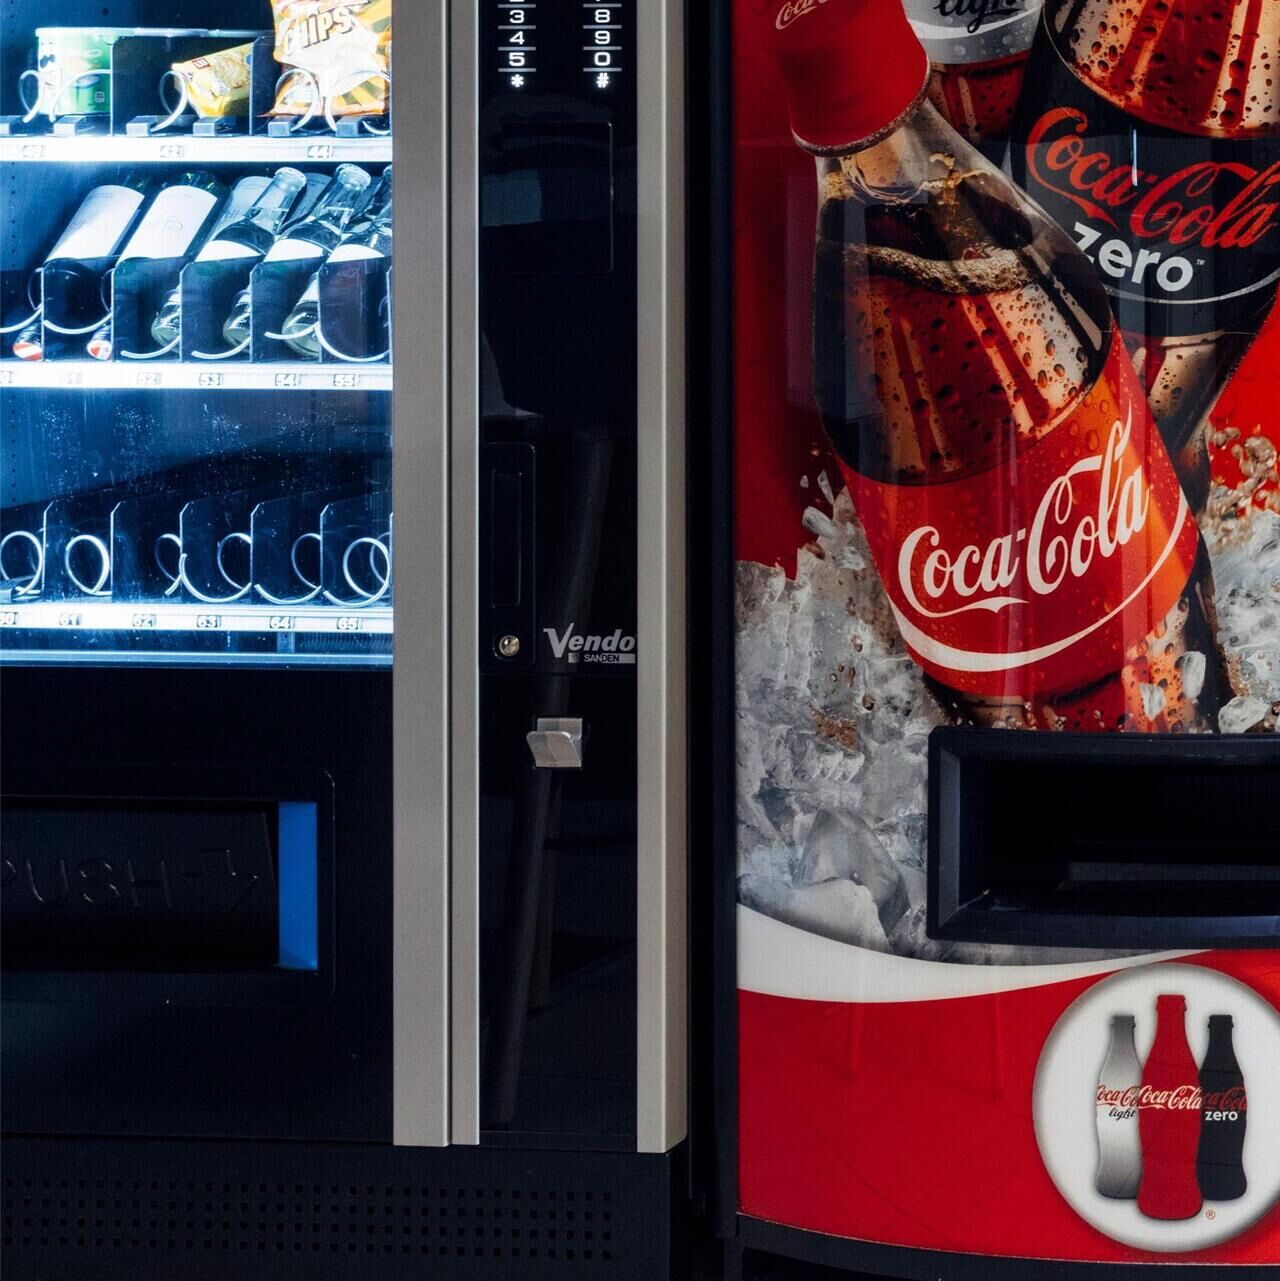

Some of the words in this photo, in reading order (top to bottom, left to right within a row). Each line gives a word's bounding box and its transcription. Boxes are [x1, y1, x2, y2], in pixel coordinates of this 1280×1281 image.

[509, 10, 525, 23] 3
[595, 10, 610, 23] 8
[509, 32, 525, 45] 4
[595, 31, 610, 44] 9
[509, 53, 525, 66] 5
[595, 52, 611, 65] 0
[1072, 222, 1194, 292] zero
[899, 401, 1152, 618] Coca-Cola
[543, 623, 635, 657] Vendo
[584, 654, 619, 663] SANDEN
[1204, 1110, 1238, 1121] zero
